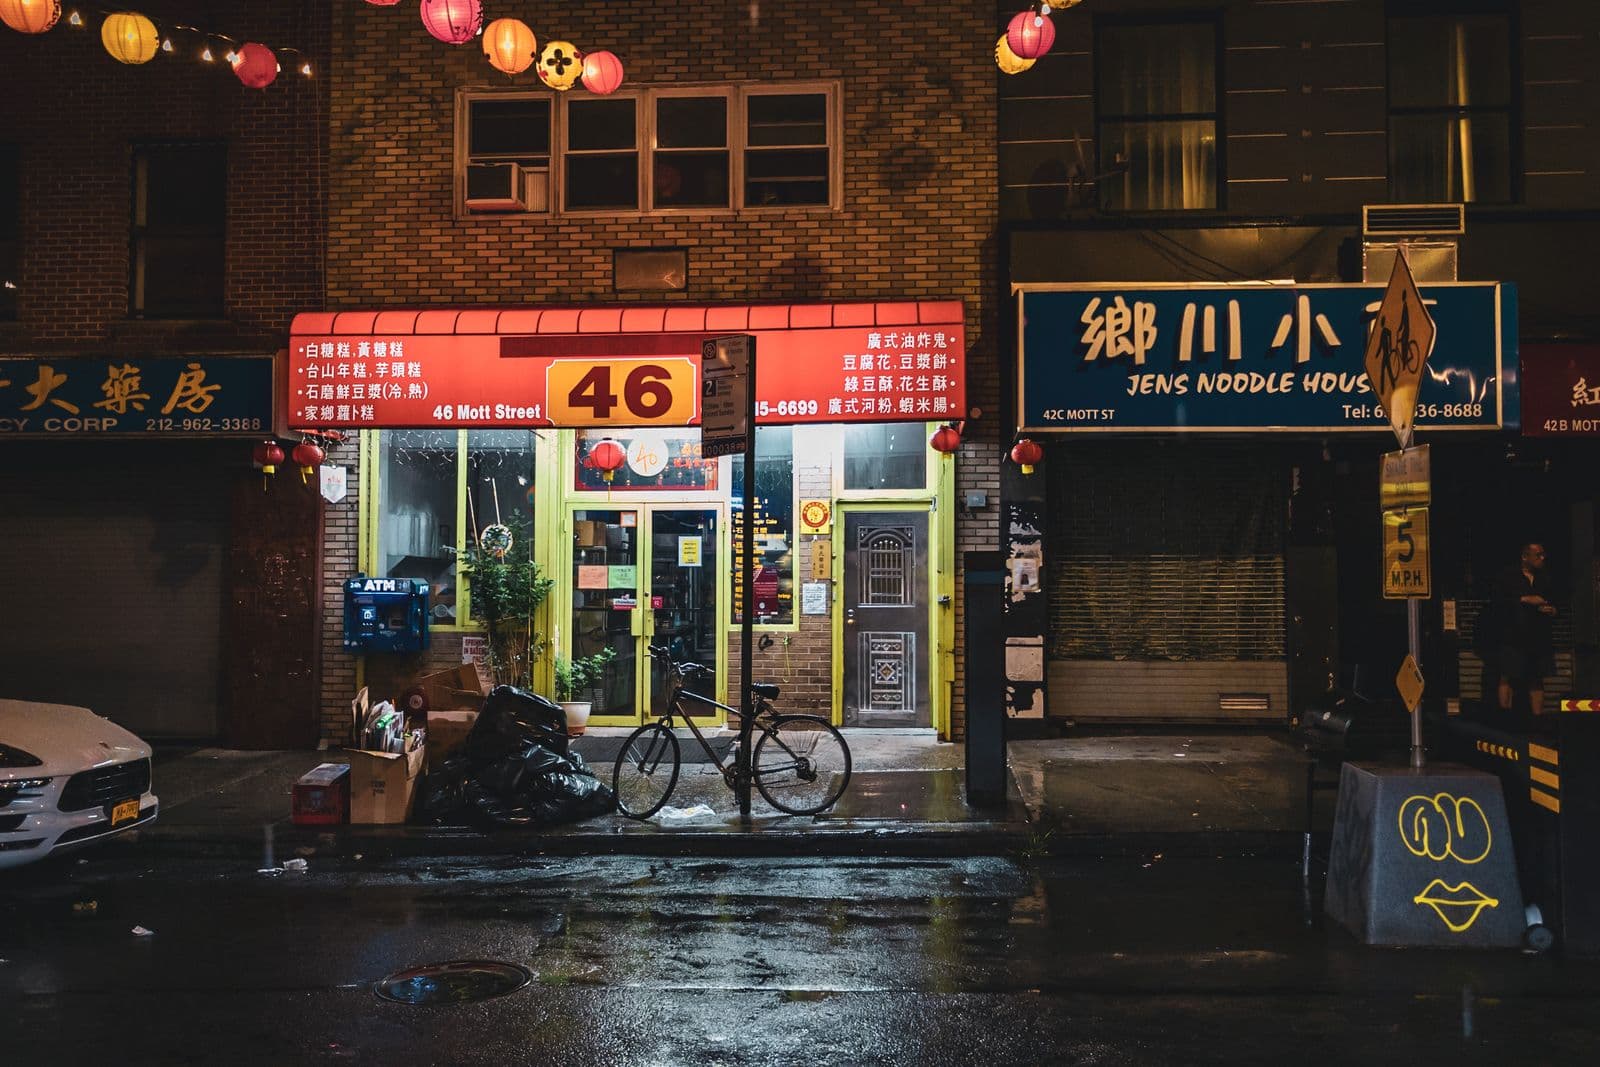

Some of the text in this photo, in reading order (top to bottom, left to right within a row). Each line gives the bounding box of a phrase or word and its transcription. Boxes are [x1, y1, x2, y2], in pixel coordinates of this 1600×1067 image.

[1080, 295, 1437, 366] 鄉川小
[867, 332, 947, 349] 廣式油炸鬼
[0, 363, 222, 415] 大藥房
[568, 364, 673, 419] 46
[705, 381, 713, 396] 2
[1127, 372, 1376, 396] JENS NOODLE HOUS
[432, 403, 541, 420] 46 Mott Street
[1043, 409, 1115, 420] 42C MOTT ST
[1342, 404, 1370, 419] Tel:
[43, 417, 118, 432] CORP
[146, 418, 261, 432] 212-962-3388
[1398, 521, 1414, 563] 5
[364, 580, 396, 591] ATM
[1391, 570, 1424, 588] M.P.H.
